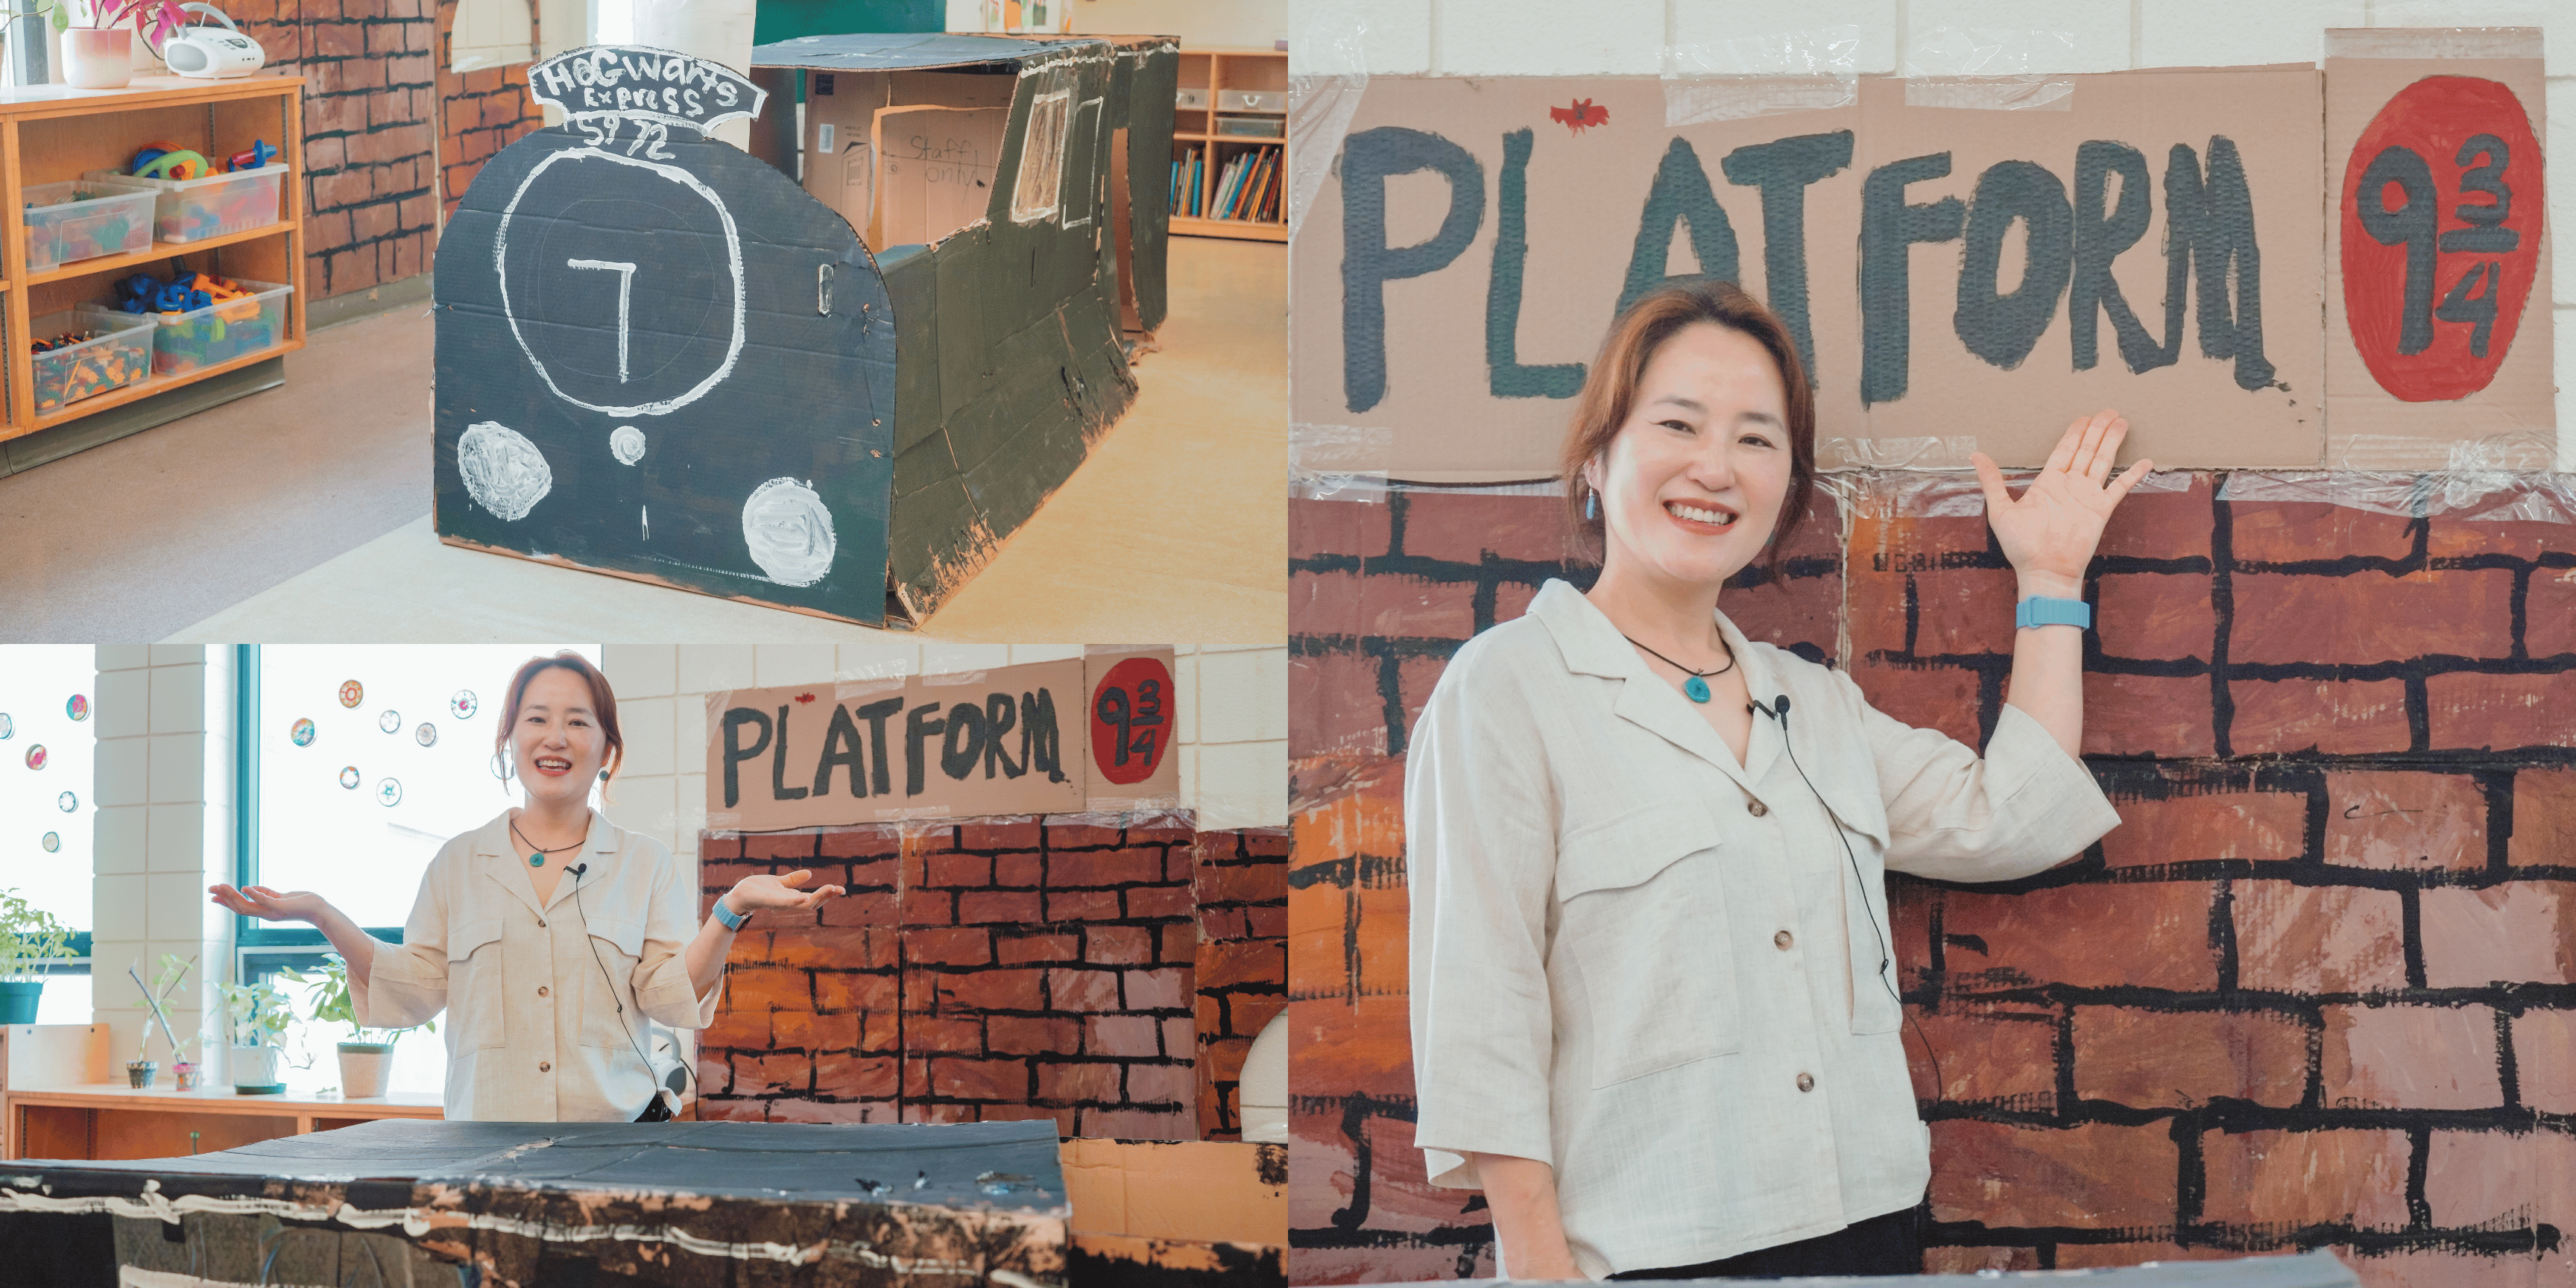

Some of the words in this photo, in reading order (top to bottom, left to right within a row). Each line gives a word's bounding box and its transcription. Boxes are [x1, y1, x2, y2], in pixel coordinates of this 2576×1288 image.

[910, 135, 972, 161] Staff
[1339, 125, 2279, 414] PLATFORM
[722, 686, 1066, 809] PLATFORM
